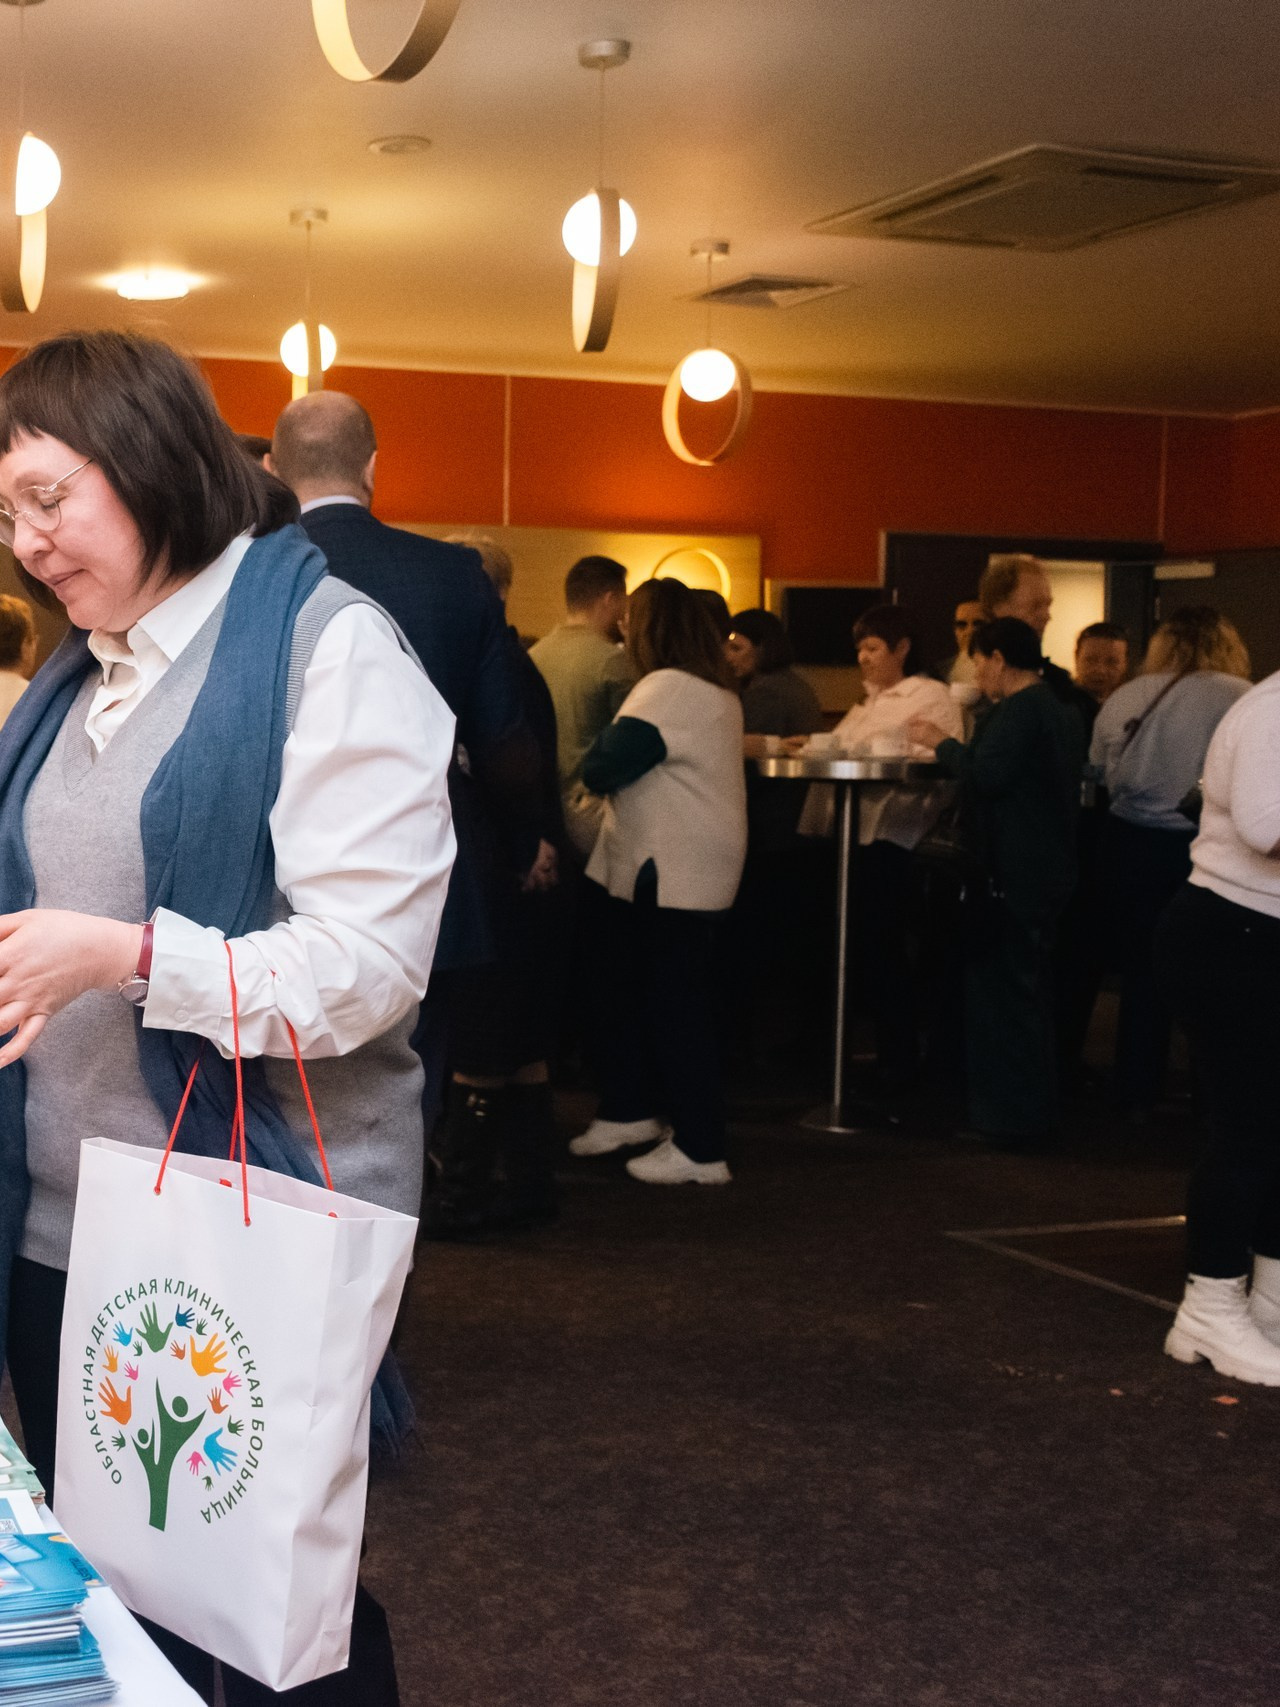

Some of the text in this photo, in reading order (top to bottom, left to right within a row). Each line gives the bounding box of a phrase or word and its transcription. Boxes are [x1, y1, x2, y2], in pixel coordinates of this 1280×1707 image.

[82, 1277, 265, 1524] ОБЛАСТНАЯ ДЕТСКАЯ КЛИНИЧЕСКАЯ БОЛЬНИЦА
